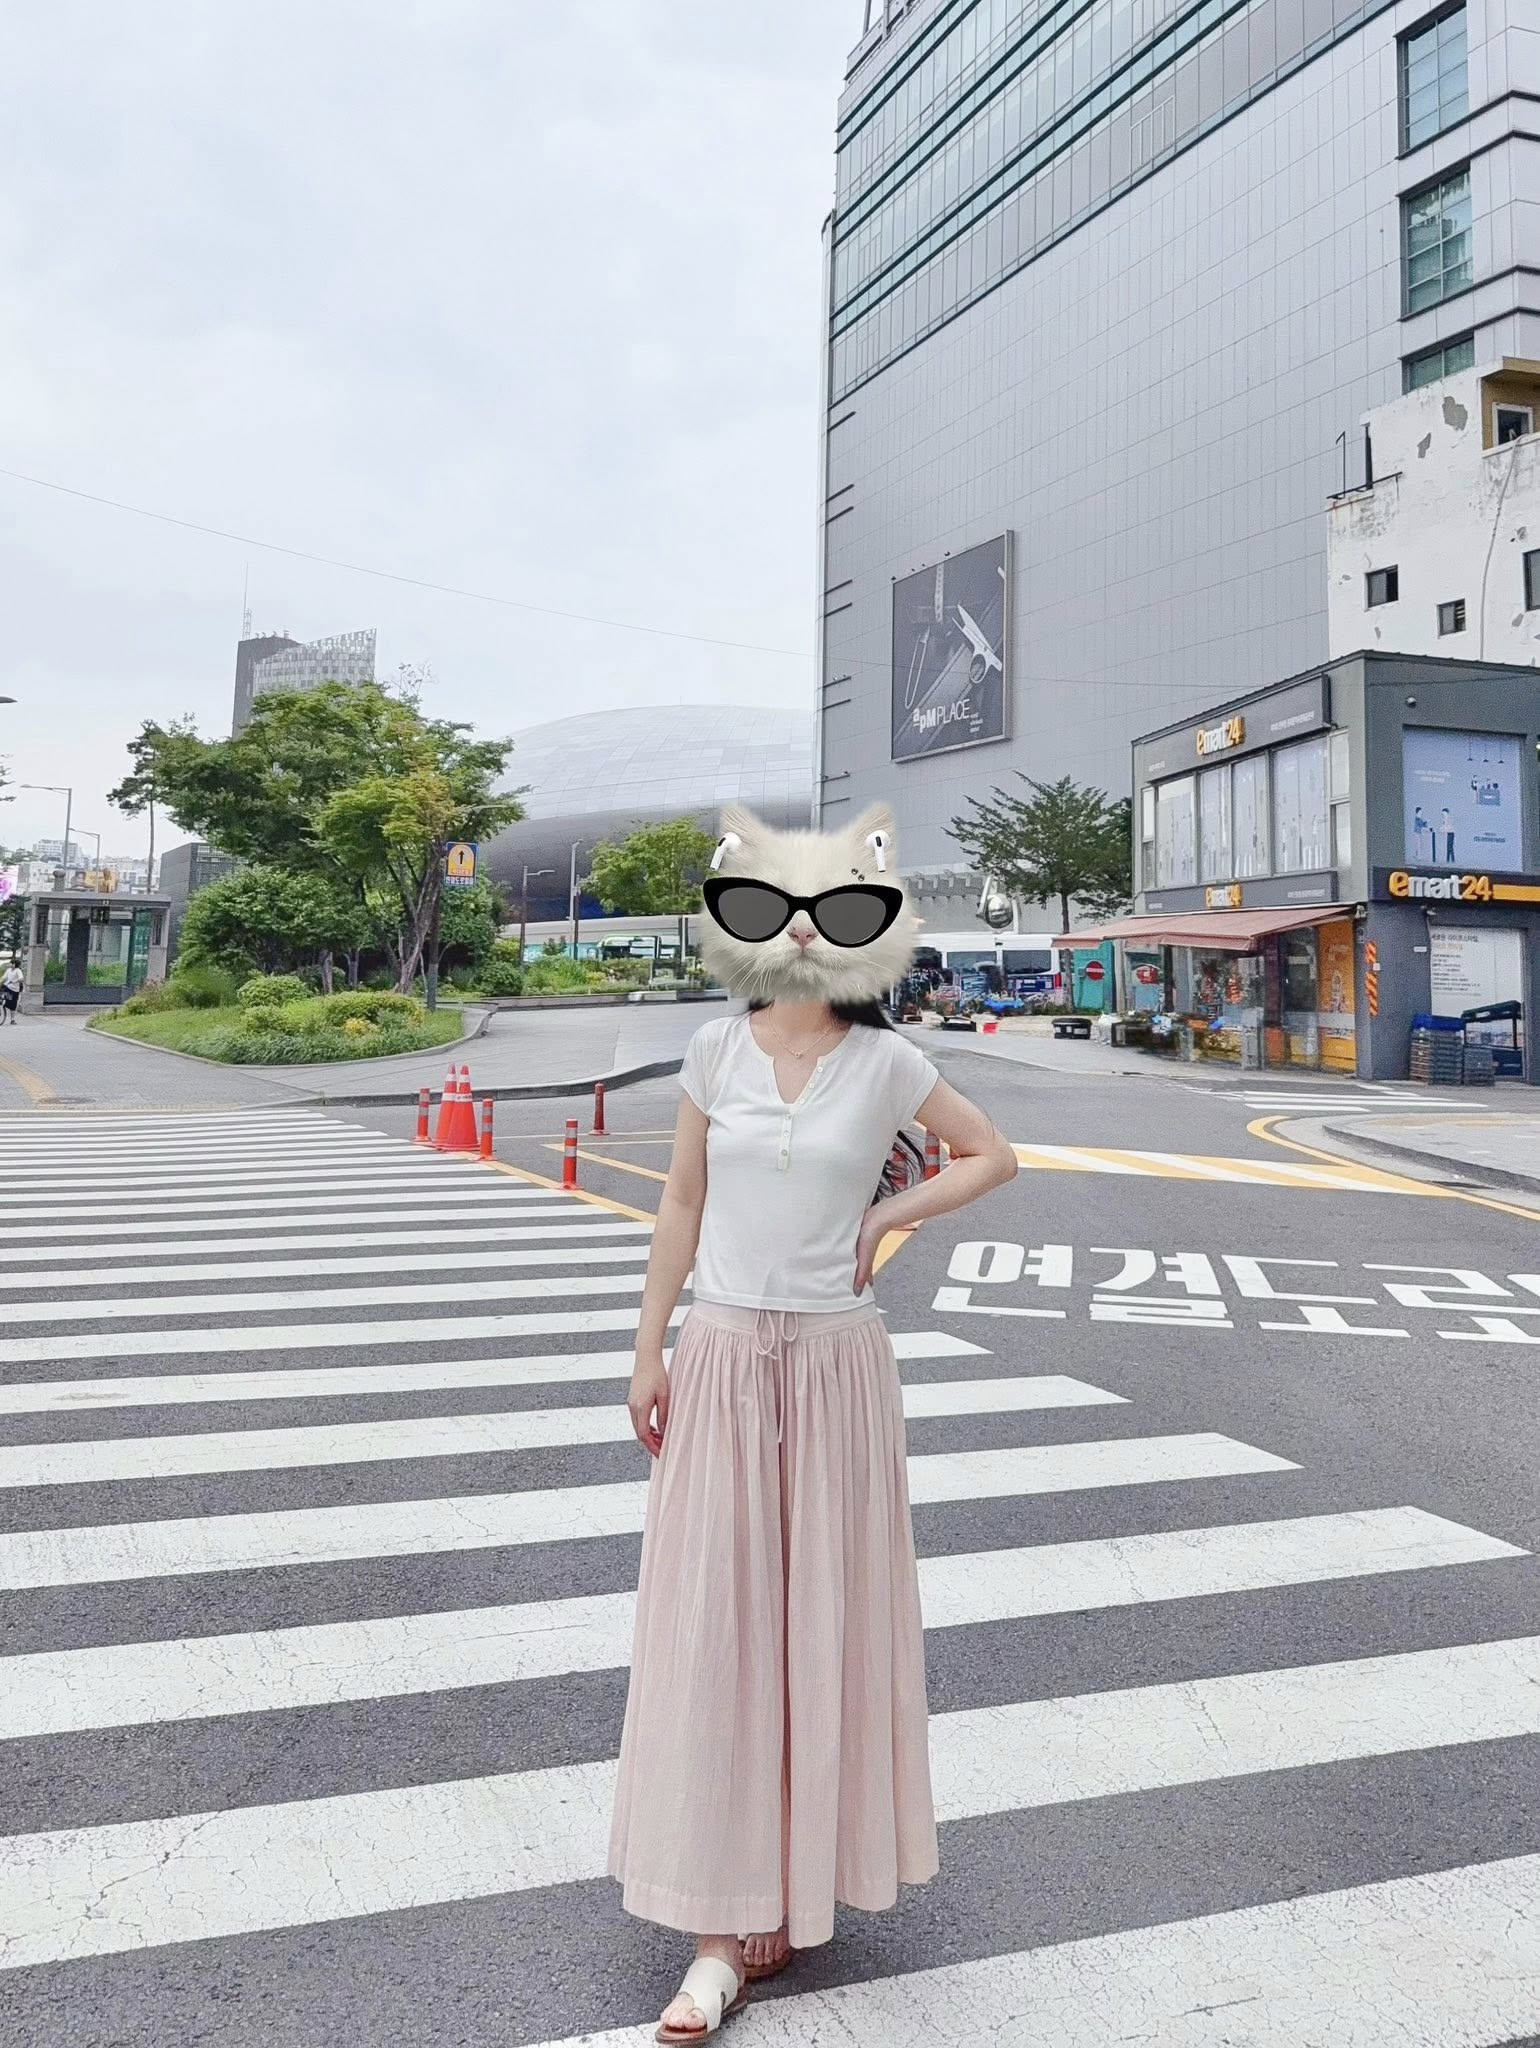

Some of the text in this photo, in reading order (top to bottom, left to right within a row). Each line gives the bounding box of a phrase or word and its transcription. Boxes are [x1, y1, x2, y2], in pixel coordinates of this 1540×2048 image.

[937, 699, 970, 725] PLACE
[1197, 715, 1245, 755] emart24
[1388, 871, 1492, 901] emart24
[931, 1240, 1540, 1344] 연결도로
